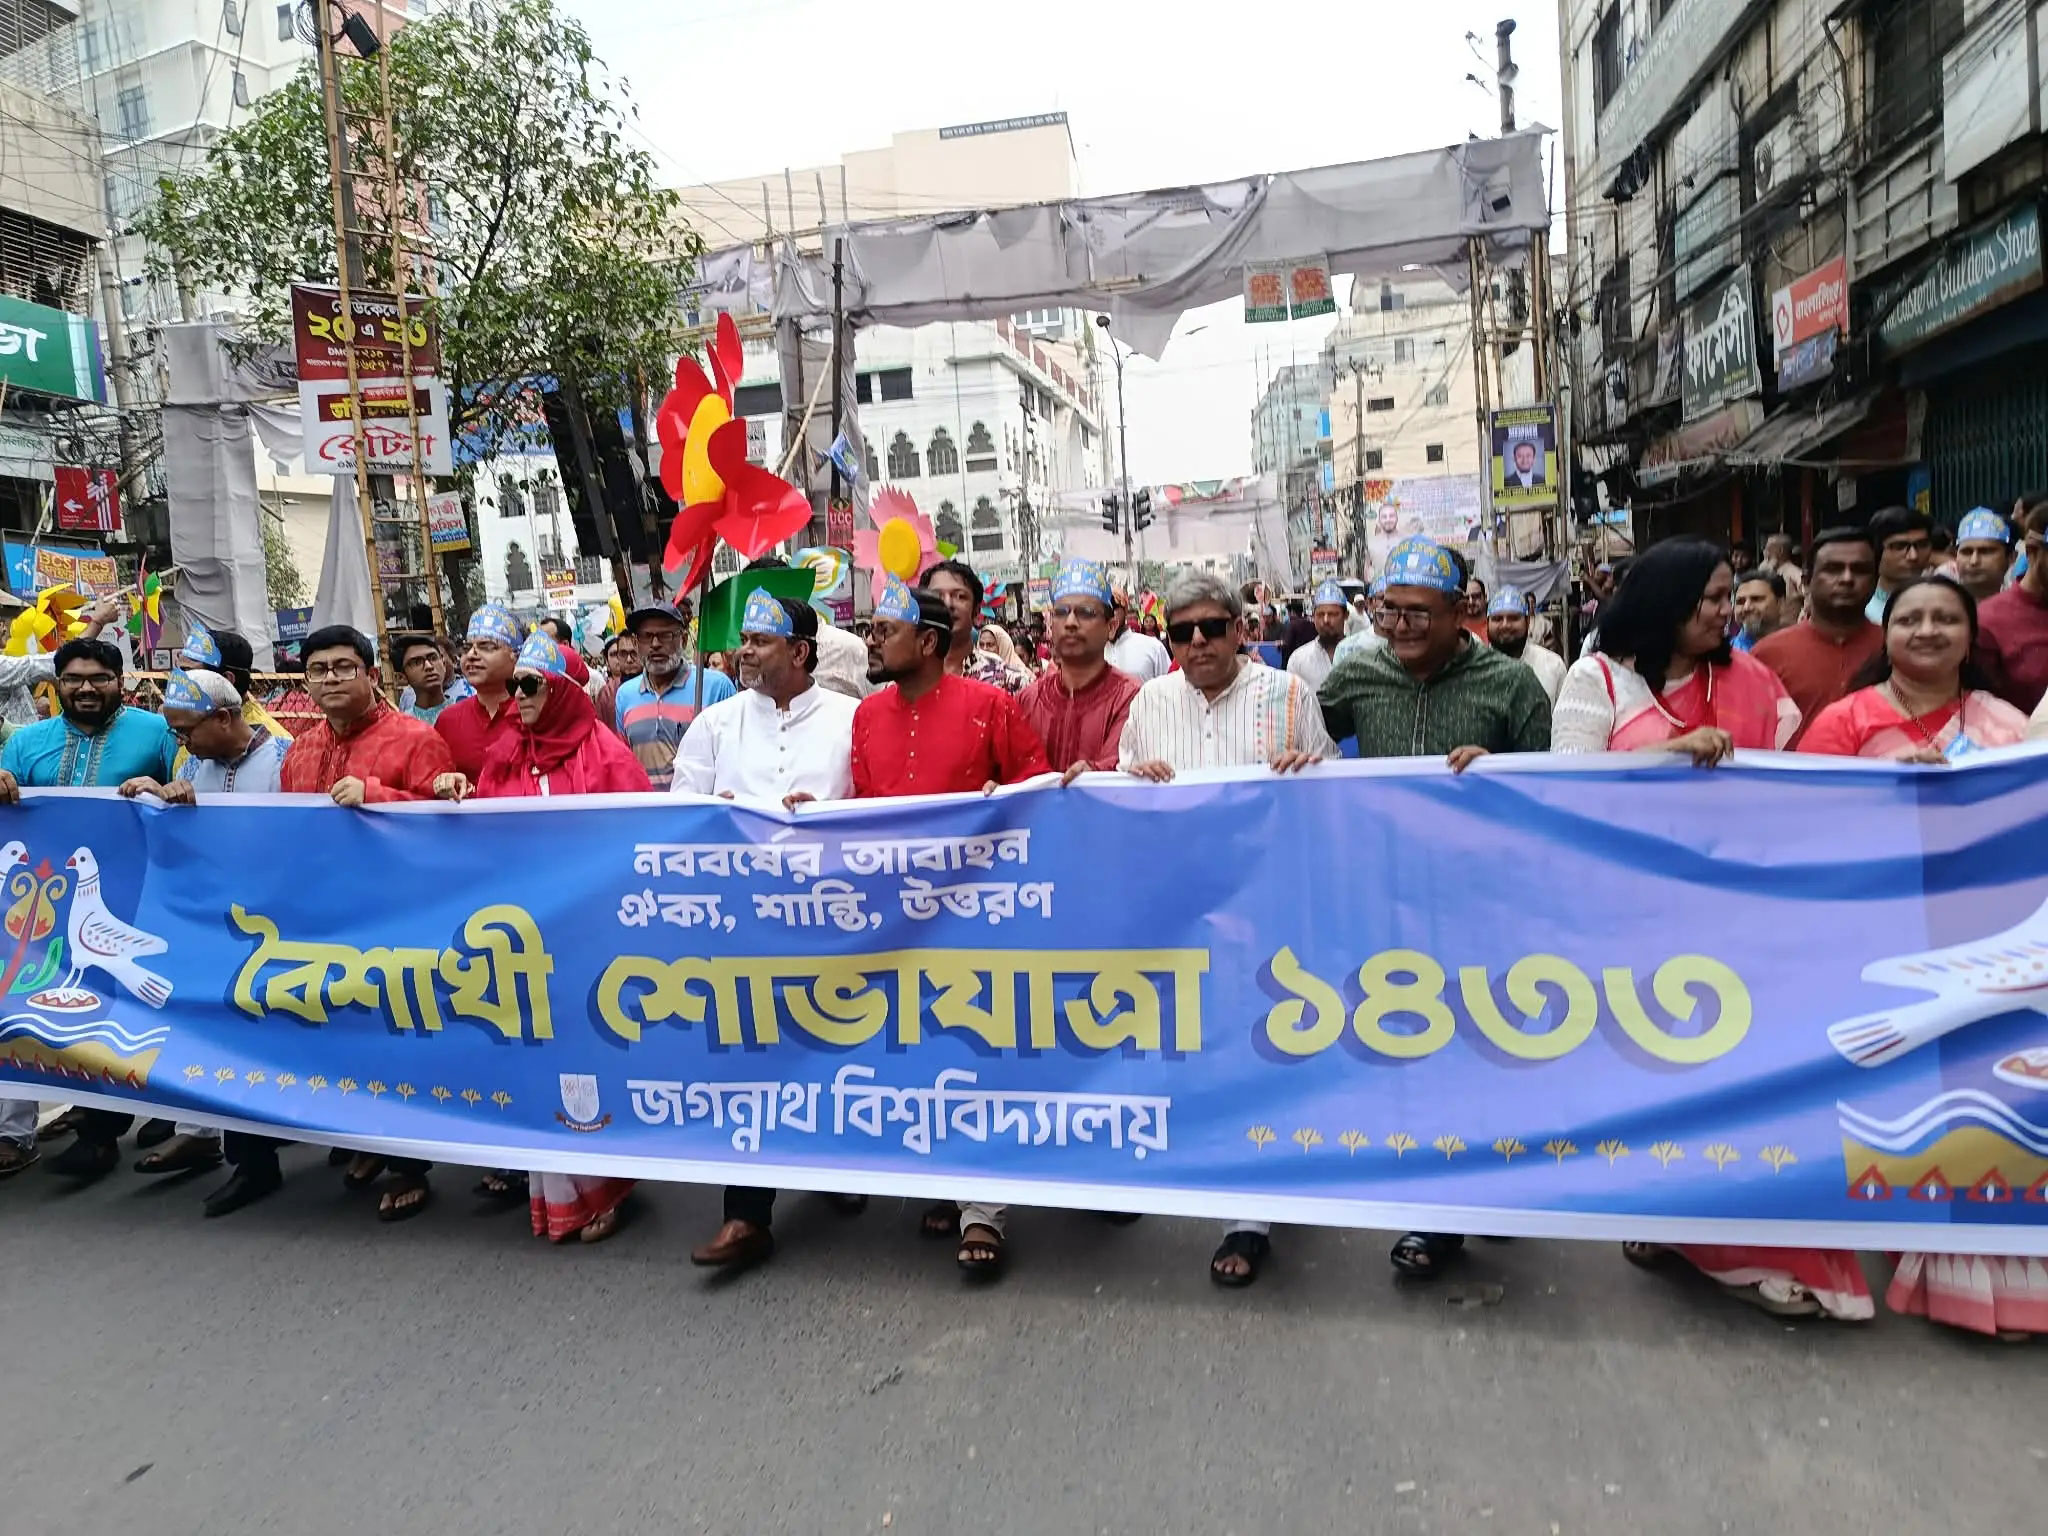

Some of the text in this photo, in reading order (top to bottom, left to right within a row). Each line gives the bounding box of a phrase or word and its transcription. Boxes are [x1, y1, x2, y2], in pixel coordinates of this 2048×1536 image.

[1937, 240, 1996, 303] Builders
[1996, 218, 2038, 273] Store
[829, 511, 853, 524] UCC
[39, 550, 72, 571] BCS
[80, 560, 110, 574] BCS
[633, 827, 1031, 884] নববর্ষের আবাহন
[617, 877, 1055, 933] ঐক্য, শান্তি, উত্তরণ
[232, 904, 1753, 1065] বৈশাখী শোভাযাত্রা ১৪৩৩
[627, 1064, 1172, 1161] জগন্নাথ বিশ্ববিদ্যালয়
